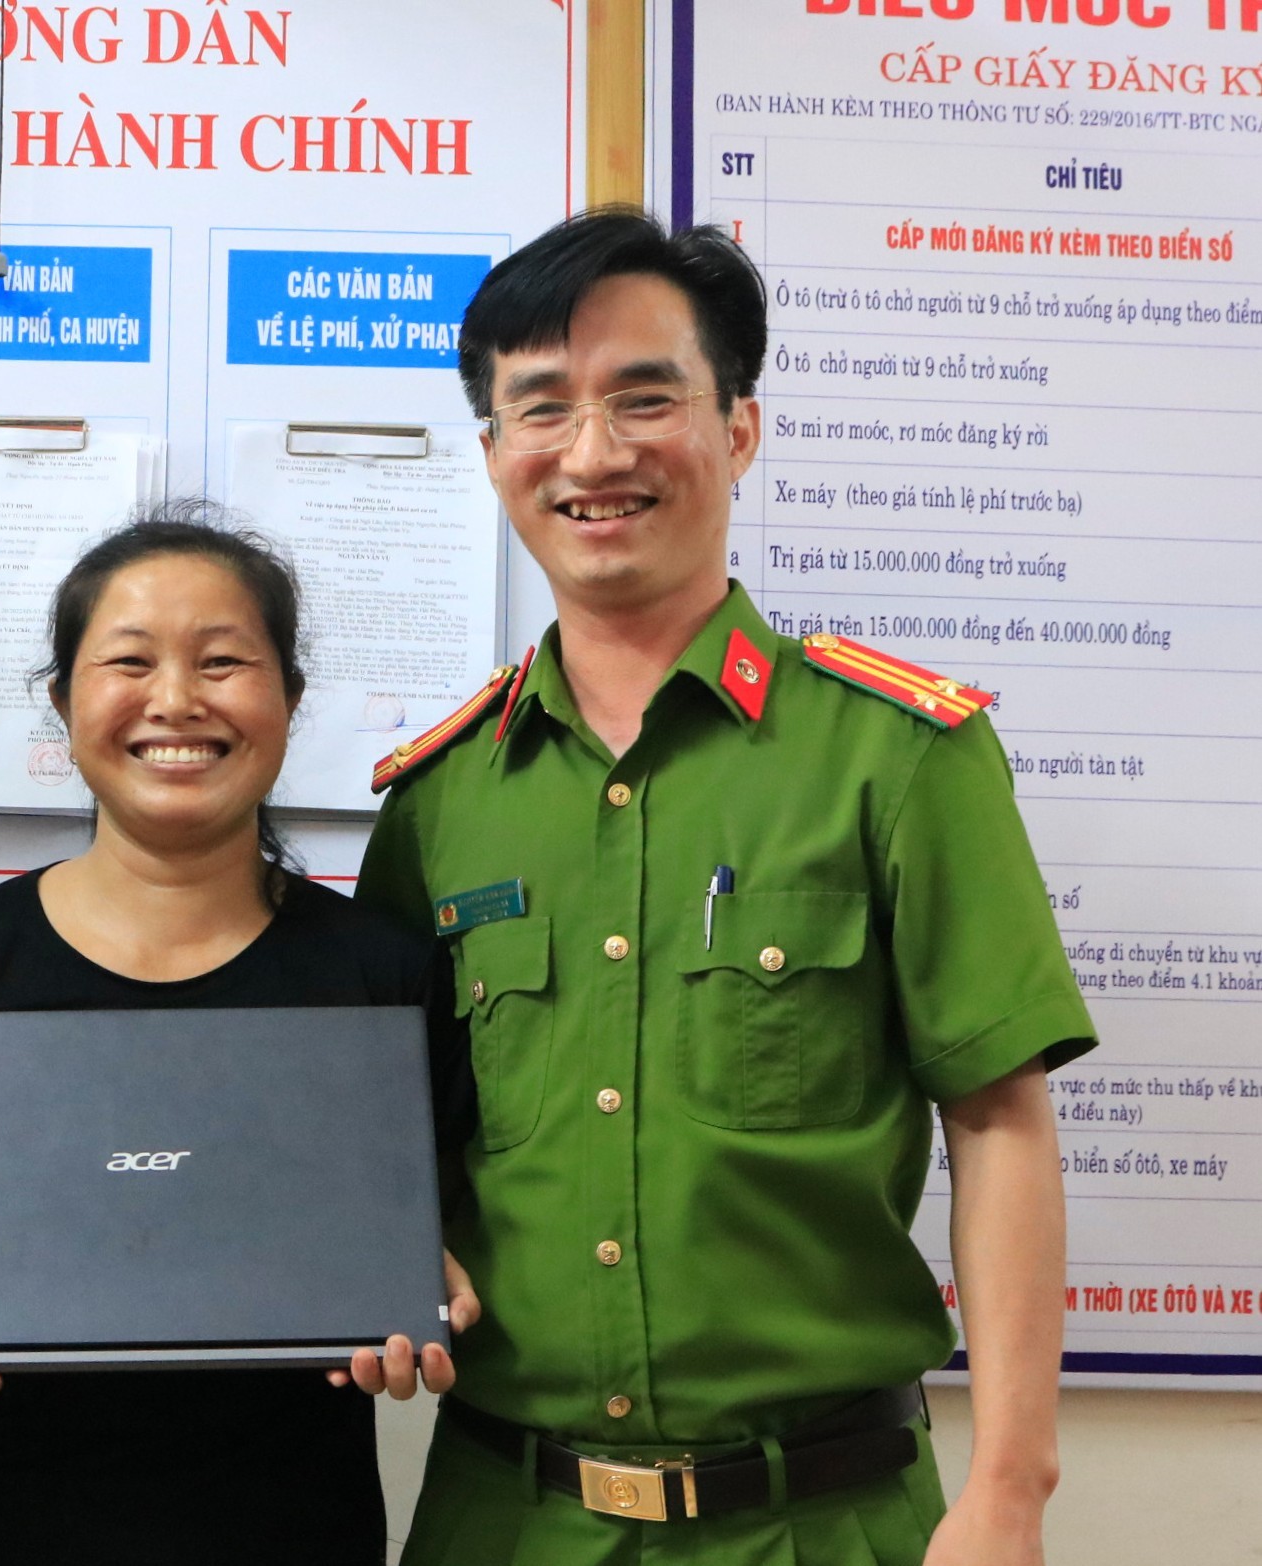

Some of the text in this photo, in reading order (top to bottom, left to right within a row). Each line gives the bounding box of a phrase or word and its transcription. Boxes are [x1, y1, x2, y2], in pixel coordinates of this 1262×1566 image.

[880, 41, 1207, 94] CẤP GIẤY ĐĂNG
[716, 92, 1225, 131] (BAN HÀNH KÈM THEO THÔNG TƯ SỐ: 229/2016/TT-BTC
[10, 93, 218, 170] HÀNH
[240, 98, 472, 175] CHÍNH
[722, 152, 754, 176] STT
[1046, 158, 1122, 191] CHỈ TIÊU
[886, 218, 1233, 262] CẤP MỚI ĐĂNG KÝ KÈM THEO BIỂN SỐ
[40, 257, 74, 292] BẢN
[287, 265, 433, 300] CÁC VĂN BẢN
[776, 279, 1221, 326] Ô tô tô chở người từ 9 chỗ trở xuống áp dụng theo
[17, 308, 56, 346] PHỐ,
[60, 317, 82, 344] CA
[86, 313, 140, 350] HUYỆN
[257, 311, 403, 353] VỀ LỆ PHÍ, XỬ
[776, 344, 1048, 386] Ô tô người từ 9 xuống
[776, 414, 1048, 450] Sơ mi moóc, móc đăng ký rời
[775, 480, 1082, 517] Xe máy (theo giá tính phí trước bạ)
[770, 545, 1066, 582] Trị giá từ 15.000.000 đồng trở xuống
[829, 614, 1171, 651] trên 15.000.000 đồng đến 40.000.000 đồng
[1039, 752, 1144, 781] người tàn tật
[1128, 940, 1238, 966] chuyển khu
[1111, 967, 1185, 988] theo điểm
[1060, 1079, 1086, 1097] vực
[1090, 1077, 1106, 1094] có
[1111, 1078, 1142, 1095] mức
[1147, 1077, 1174, 1095] thu
[1178, 1078, 1214, 1101] thấp
[1218, 1077, 1236, 1097] về
[1072, 1101, 1142, 1125] điều này)
[106, 1152, 192, 1171] acer
[1073, 1146, 1108, 1173] biển
[1114, 1149, 1133, 1174] số
[1135, 1153, 1164, 1178] ôtô,
[1170, 1160, 1188, 1175] xe
[1193, 1154, 1228, 1181] máy
[1083, 1282, 1123, 1312] THỜI
[1129, 1288, 1158, 1314] (XE
[1164, 1284, 1197, 1313] ÔTÔ
[1203, 1285, 1225, 1313] VÀ
[1230, 1290, 1253, 1314] XE
